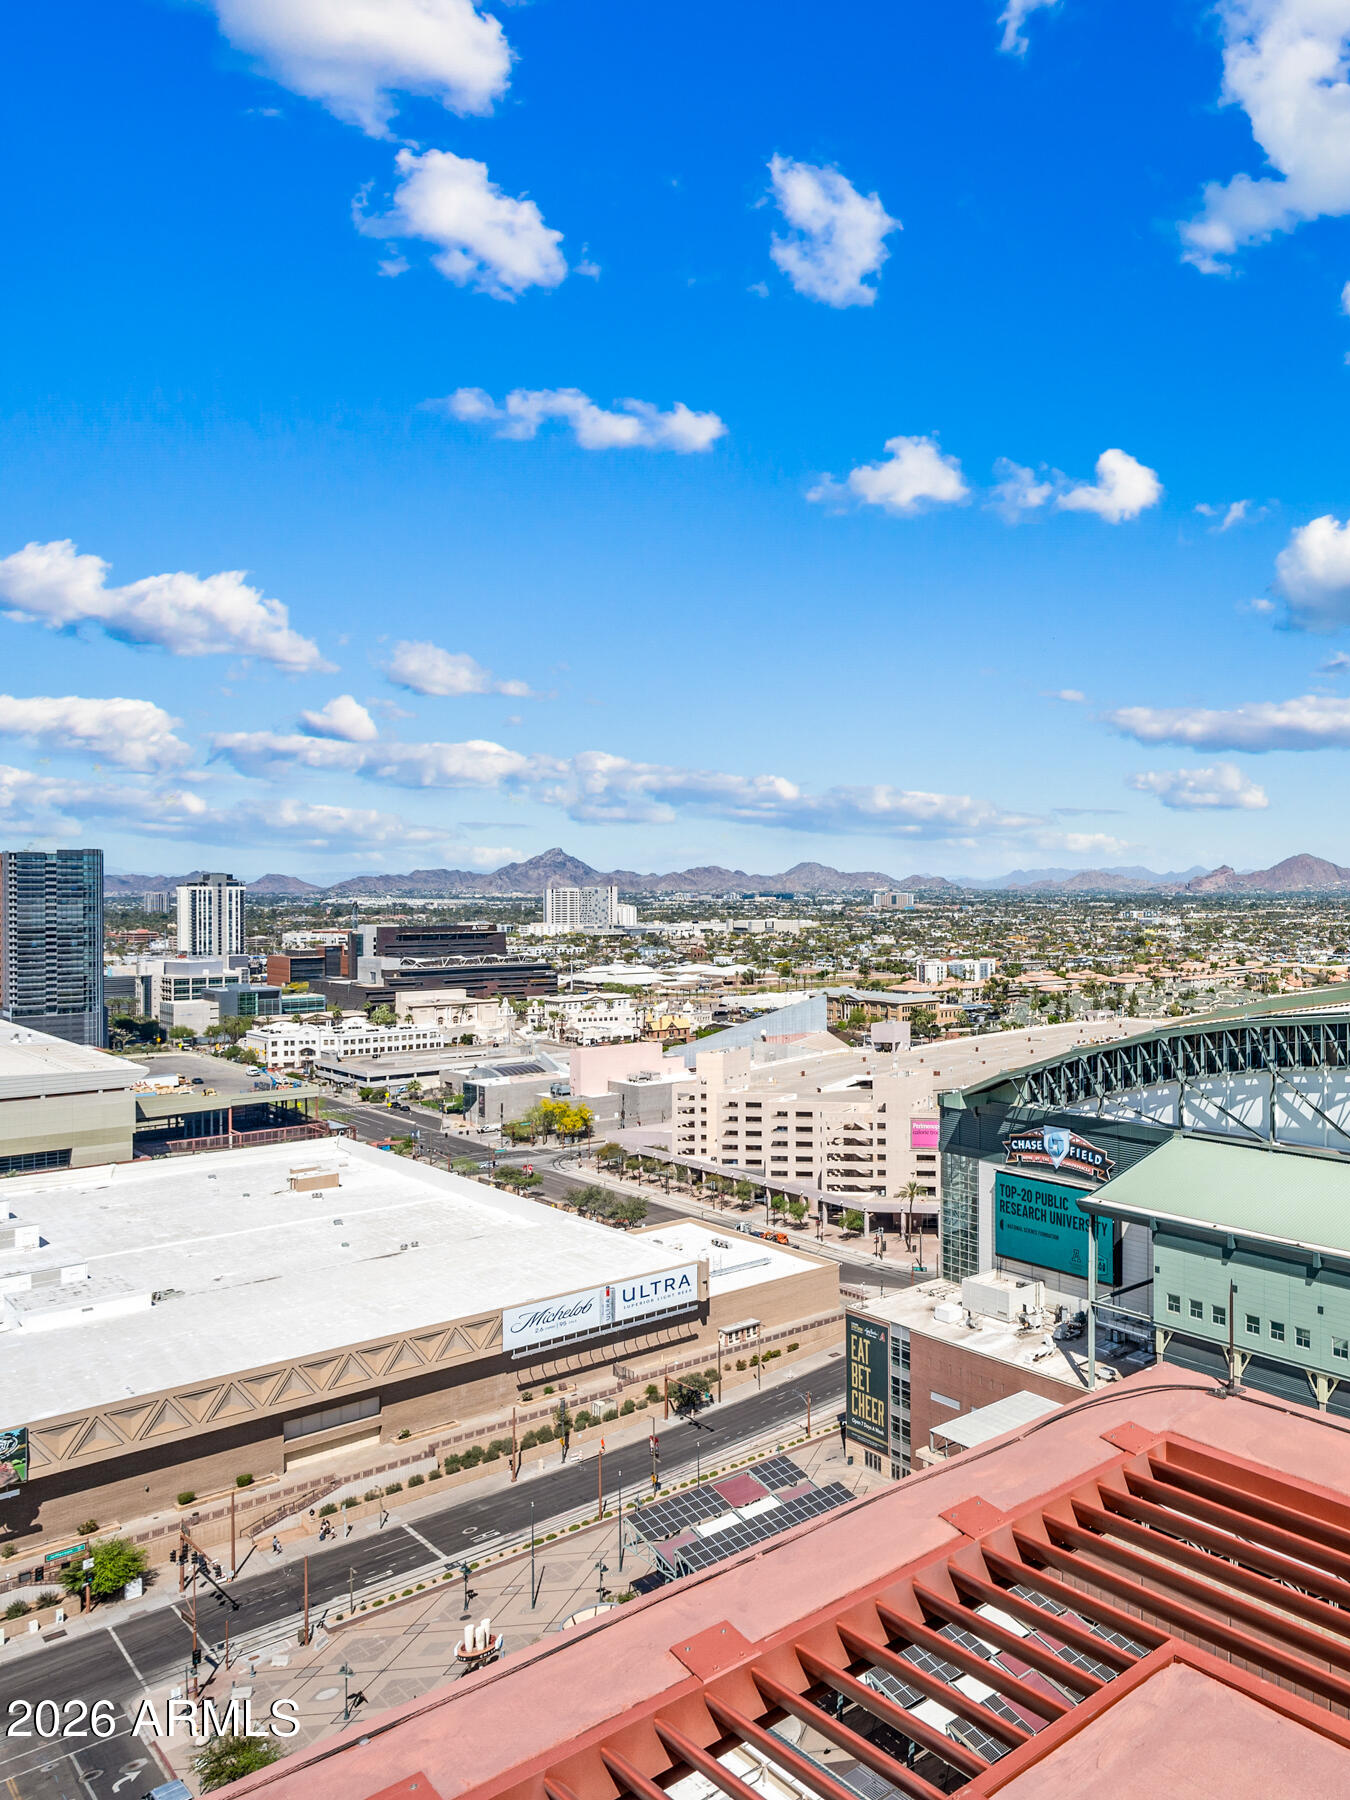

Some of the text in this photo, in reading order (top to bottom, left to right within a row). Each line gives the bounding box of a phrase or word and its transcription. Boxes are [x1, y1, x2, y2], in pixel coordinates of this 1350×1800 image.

[1011, 1139, 1103, 1165] CHASE FIELD
[999, 1184, 1069, 1210] TOP-20 PUBLIC
[1000, 1199, 1108, 1237] RESEARCH UNIVERSTY
[623, 1274, 691, 1302] ULTRA
[623, 1298, 655, 1310] SUPERIOR
[510, 1297, 596, 1333] Michelob
[851, 1333, 871, 1365] EAT
[851, 1361, 872, 1393] BET
[851, 1389, 885, 1428] CHEER
